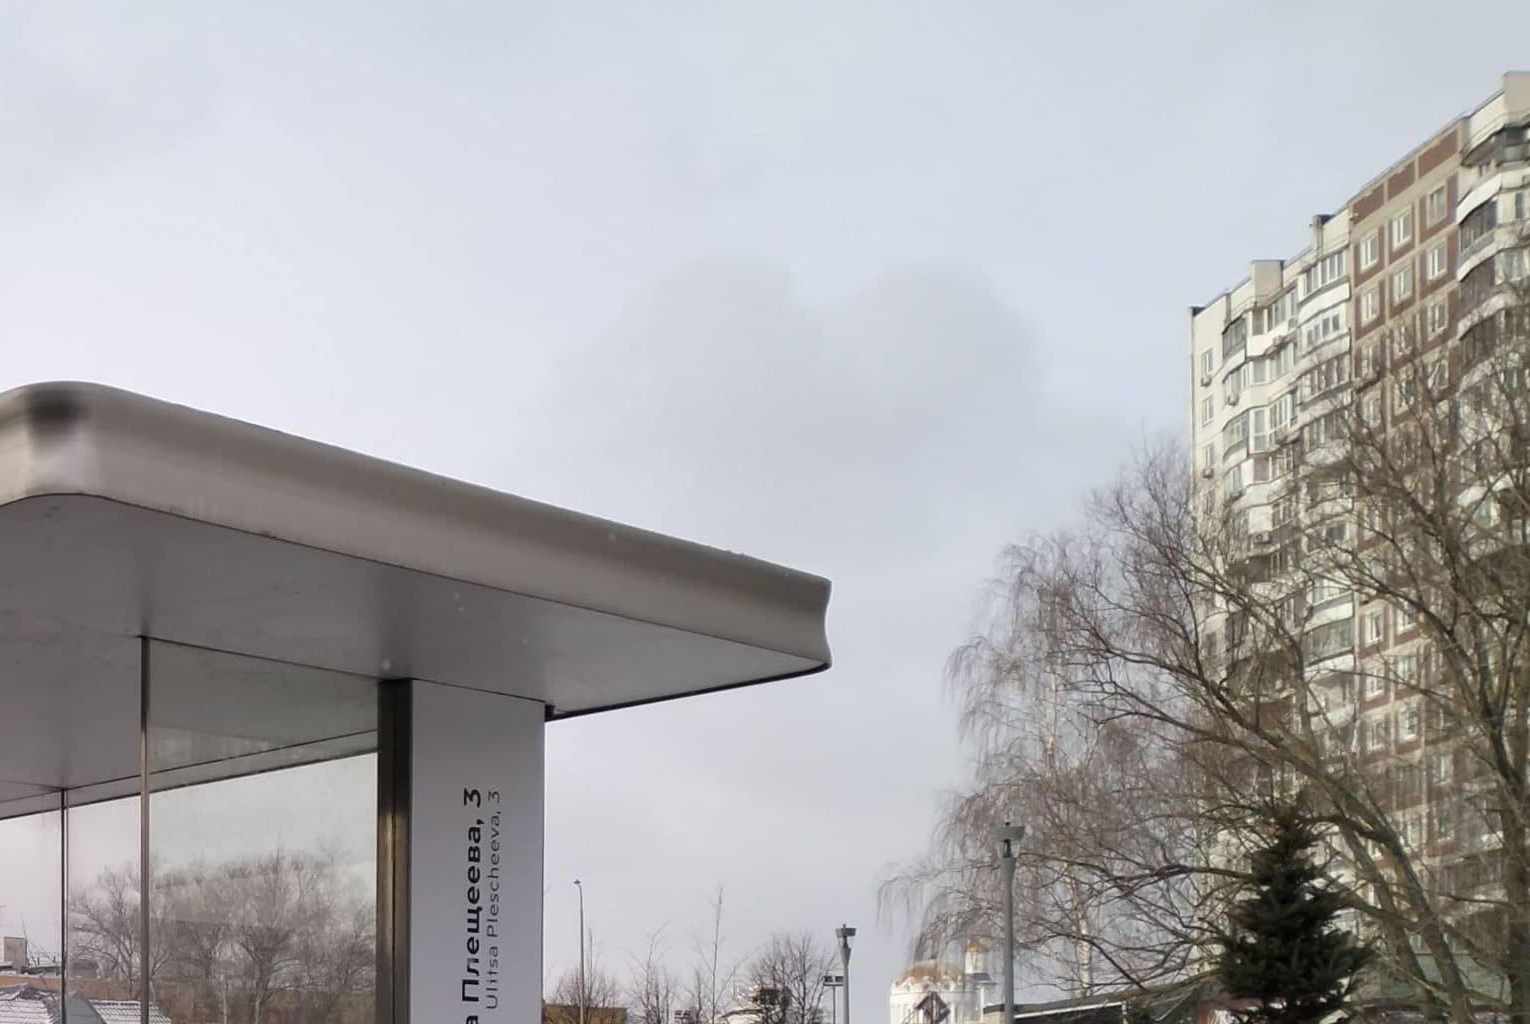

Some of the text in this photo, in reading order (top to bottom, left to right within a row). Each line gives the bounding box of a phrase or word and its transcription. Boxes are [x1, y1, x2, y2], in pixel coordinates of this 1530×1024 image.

[463, 788, 481, 808] 3
[462, 818, 484, 1002] Плещеева,
[485, 790, 502, 1010] Ulitsa Plescheeva, 3
